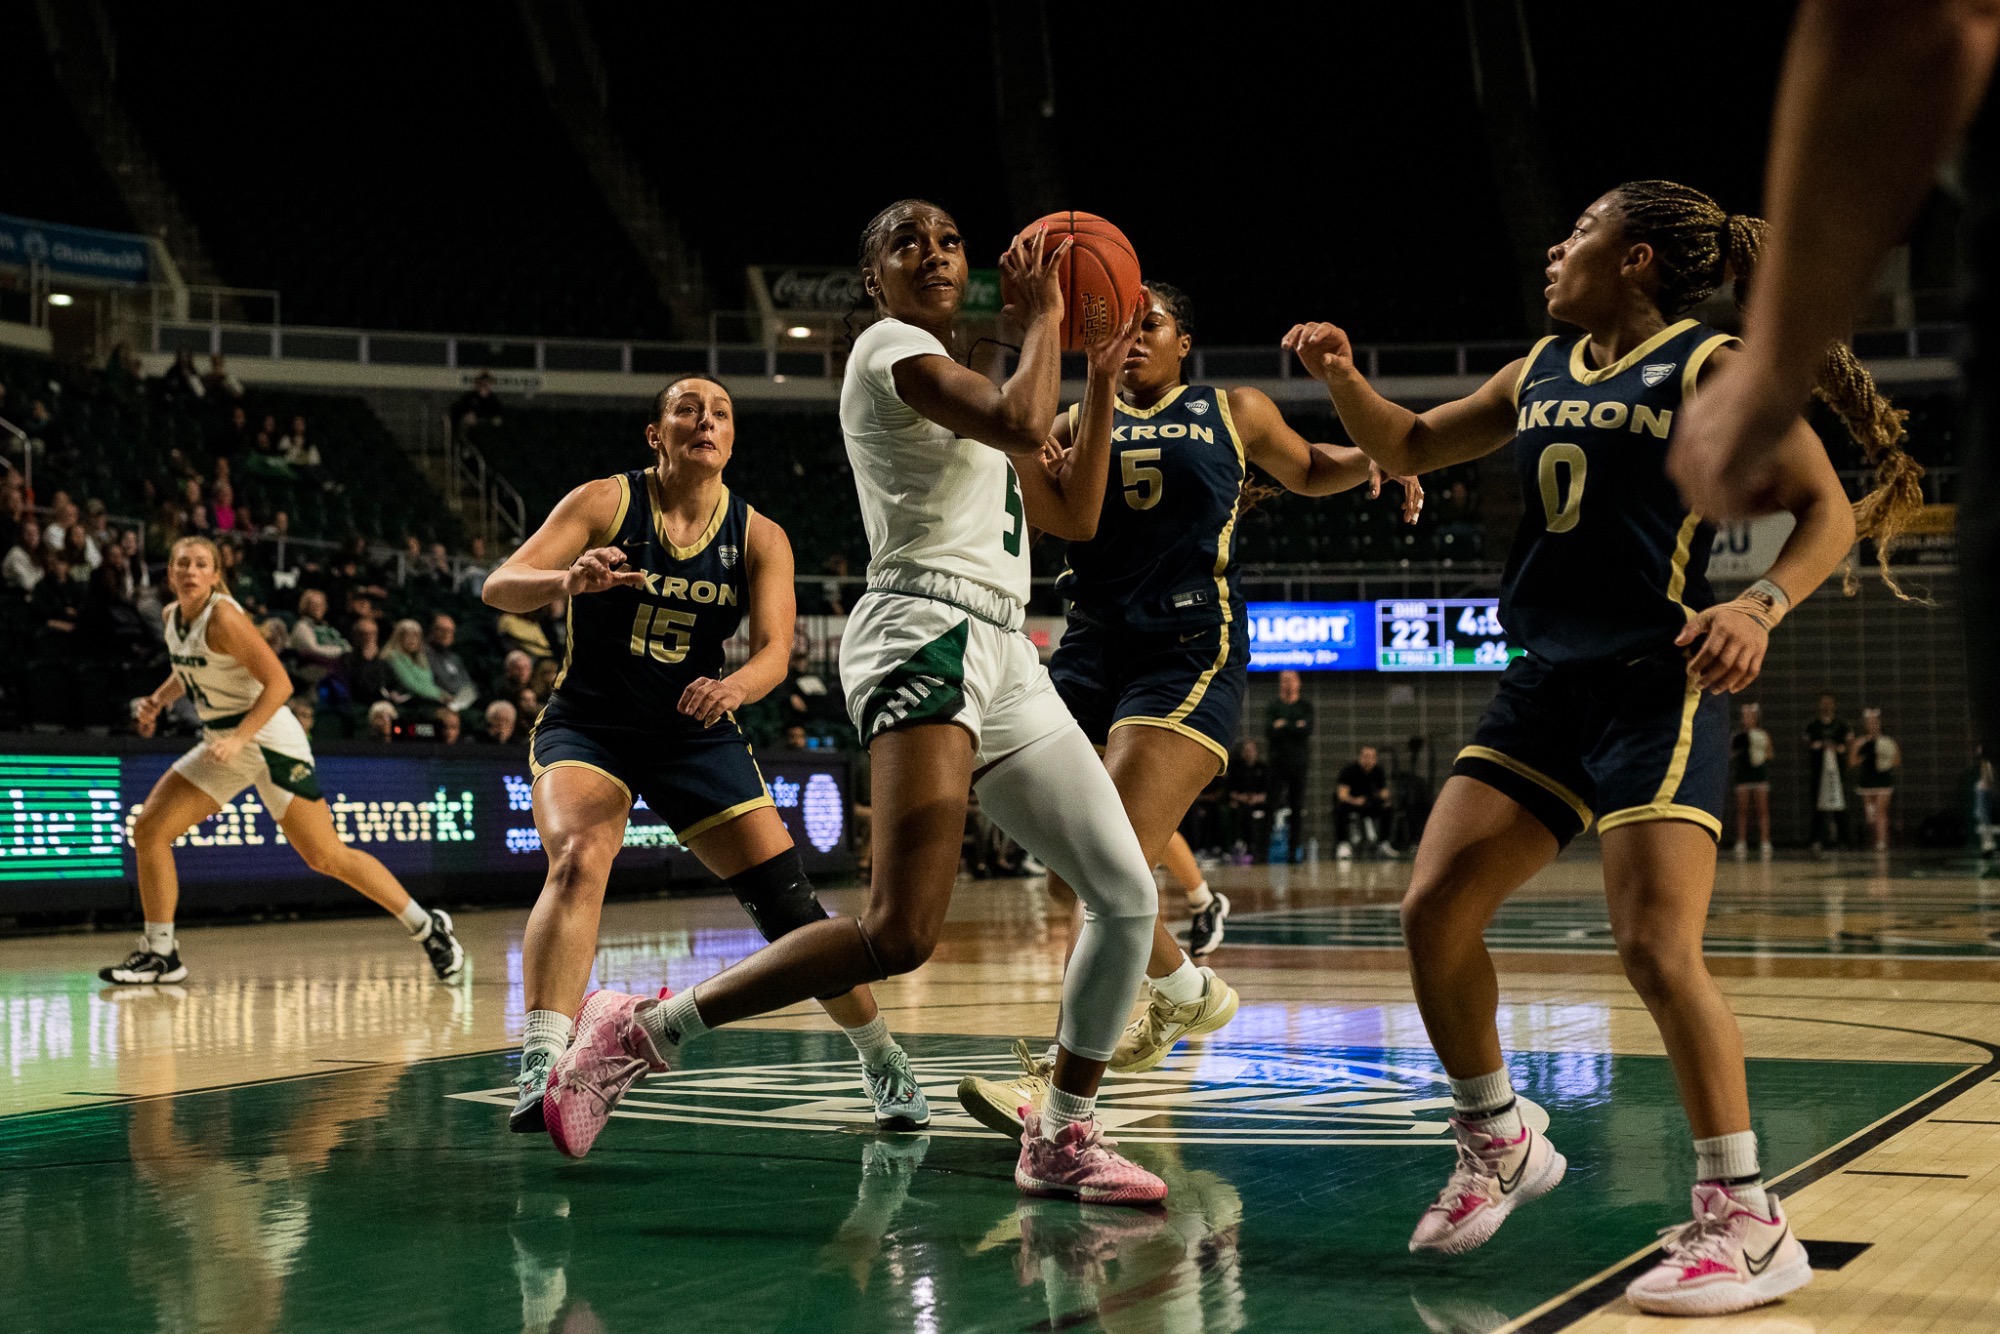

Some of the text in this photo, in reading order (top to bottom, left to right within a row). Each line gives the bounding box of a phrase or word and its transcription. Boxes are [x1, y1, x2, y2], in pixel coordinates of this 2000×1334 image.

[1080, 292, 1099, 346] EGACY
[1110, 422, 1214, 445] KRON
[1120, 447, 1163, 511] 5
[1538, 442, 1588, 533] 0
[632, 568, 738, 607] KRON
[630, 602, 698, 665] 15
[1256, 616, 1349, 643] LIGHT
[1391, 619, 1430, 650] 22
[276, 786, 475, 845] twork!
